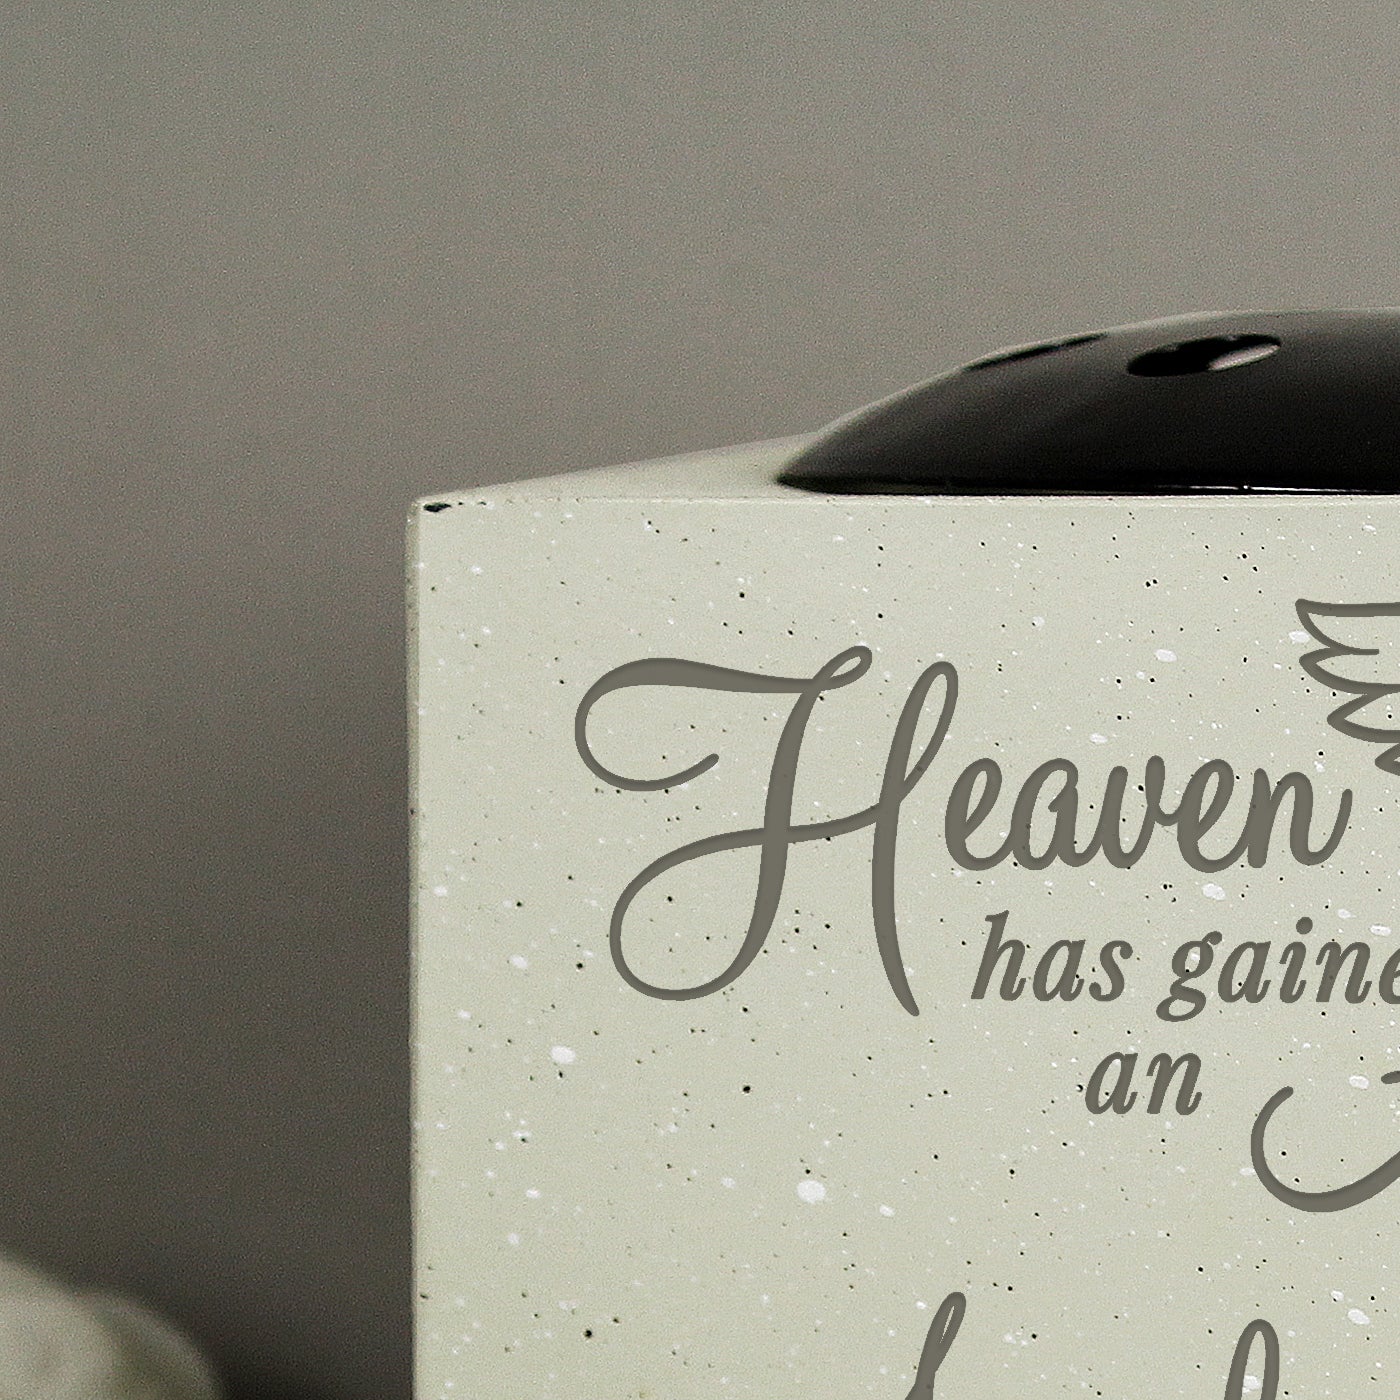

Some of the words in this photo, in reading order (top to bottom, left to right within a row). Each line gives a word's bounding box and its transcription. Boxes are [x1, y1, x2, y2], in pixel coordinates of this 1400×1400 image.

[575, 646, 1352, 1017] Heaven
[971, 911, 1133, 1001] has
[1085, 1052, 1202, 1115] an
